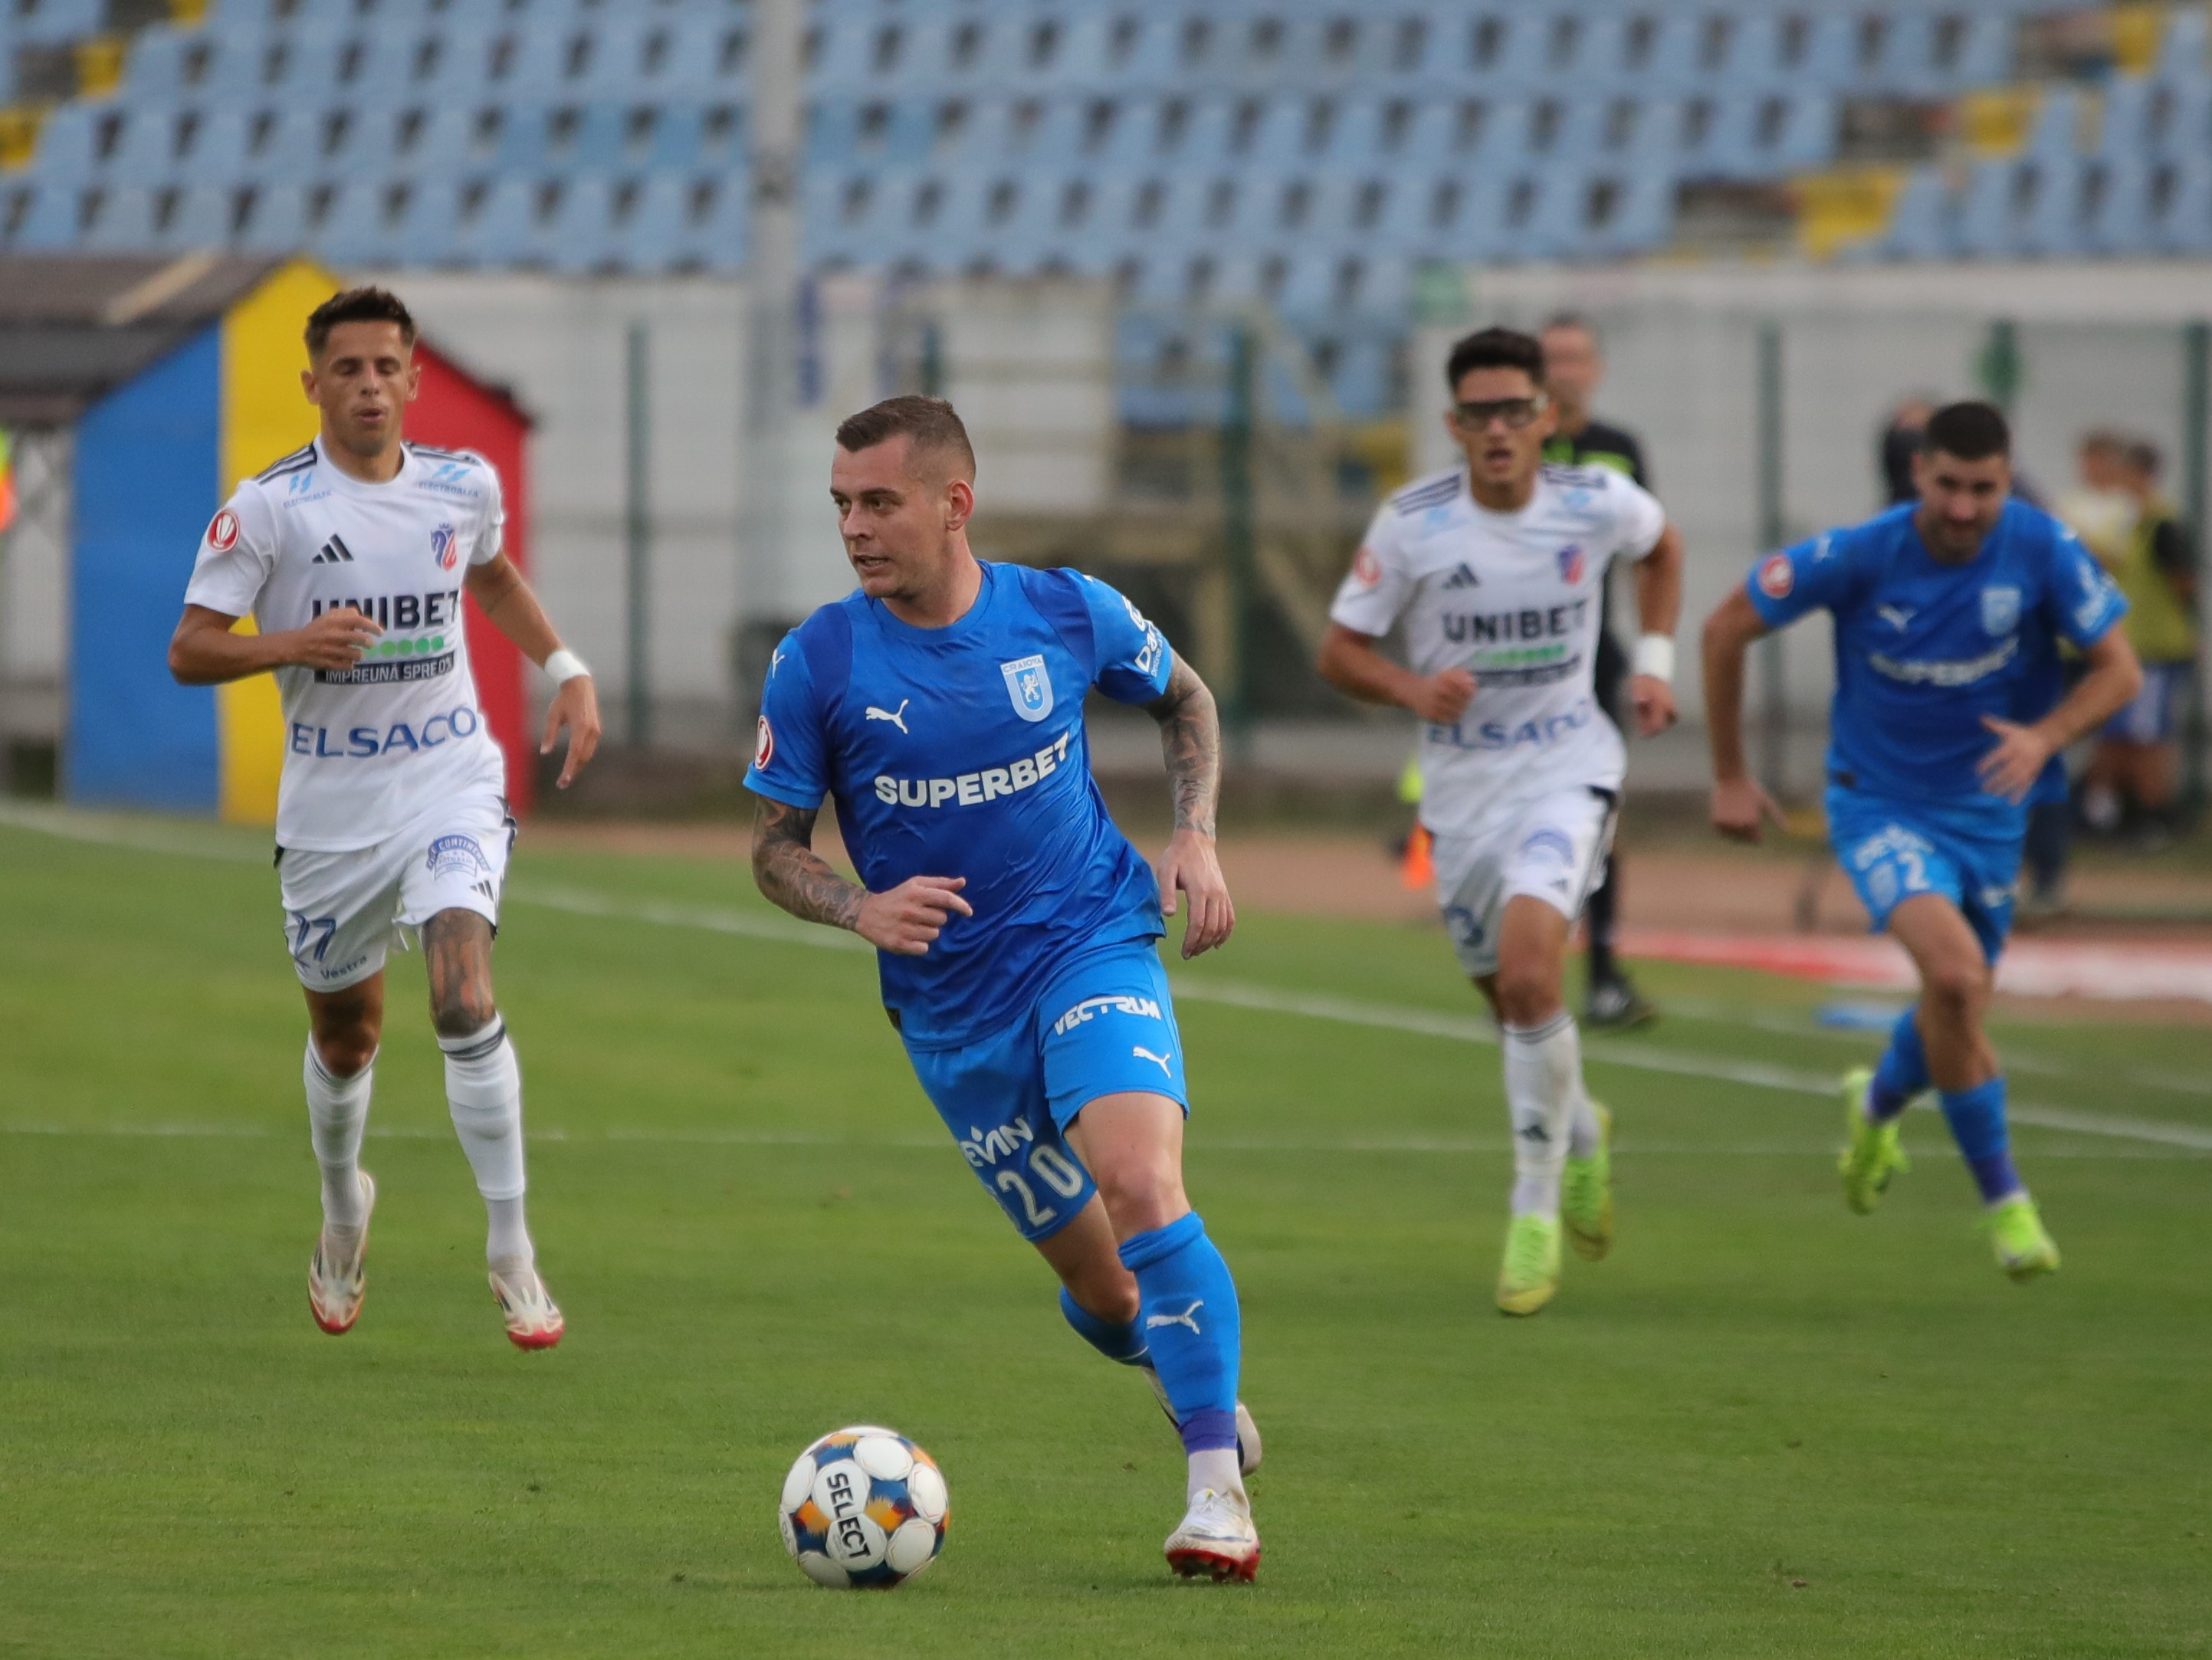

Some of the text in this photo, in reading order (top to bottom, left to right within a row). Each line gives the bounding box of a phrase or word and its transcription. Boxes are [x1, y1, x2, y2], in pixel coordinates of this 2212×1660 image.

[1442, 599, 1588, 643] UNIBET
[403, 661, 438, 679] SPRE
[1003, 657, 1042, 673] CRAIOVA
[290, 706, 477, 758] ELSACO
[874, 732, 1069, 809] SUPERBET
[1054, 996, 1162, 1036] VECTRUM
[996, 1145, 1084, 1226] 20
[826, 1472, 871, 1559] SELECT
